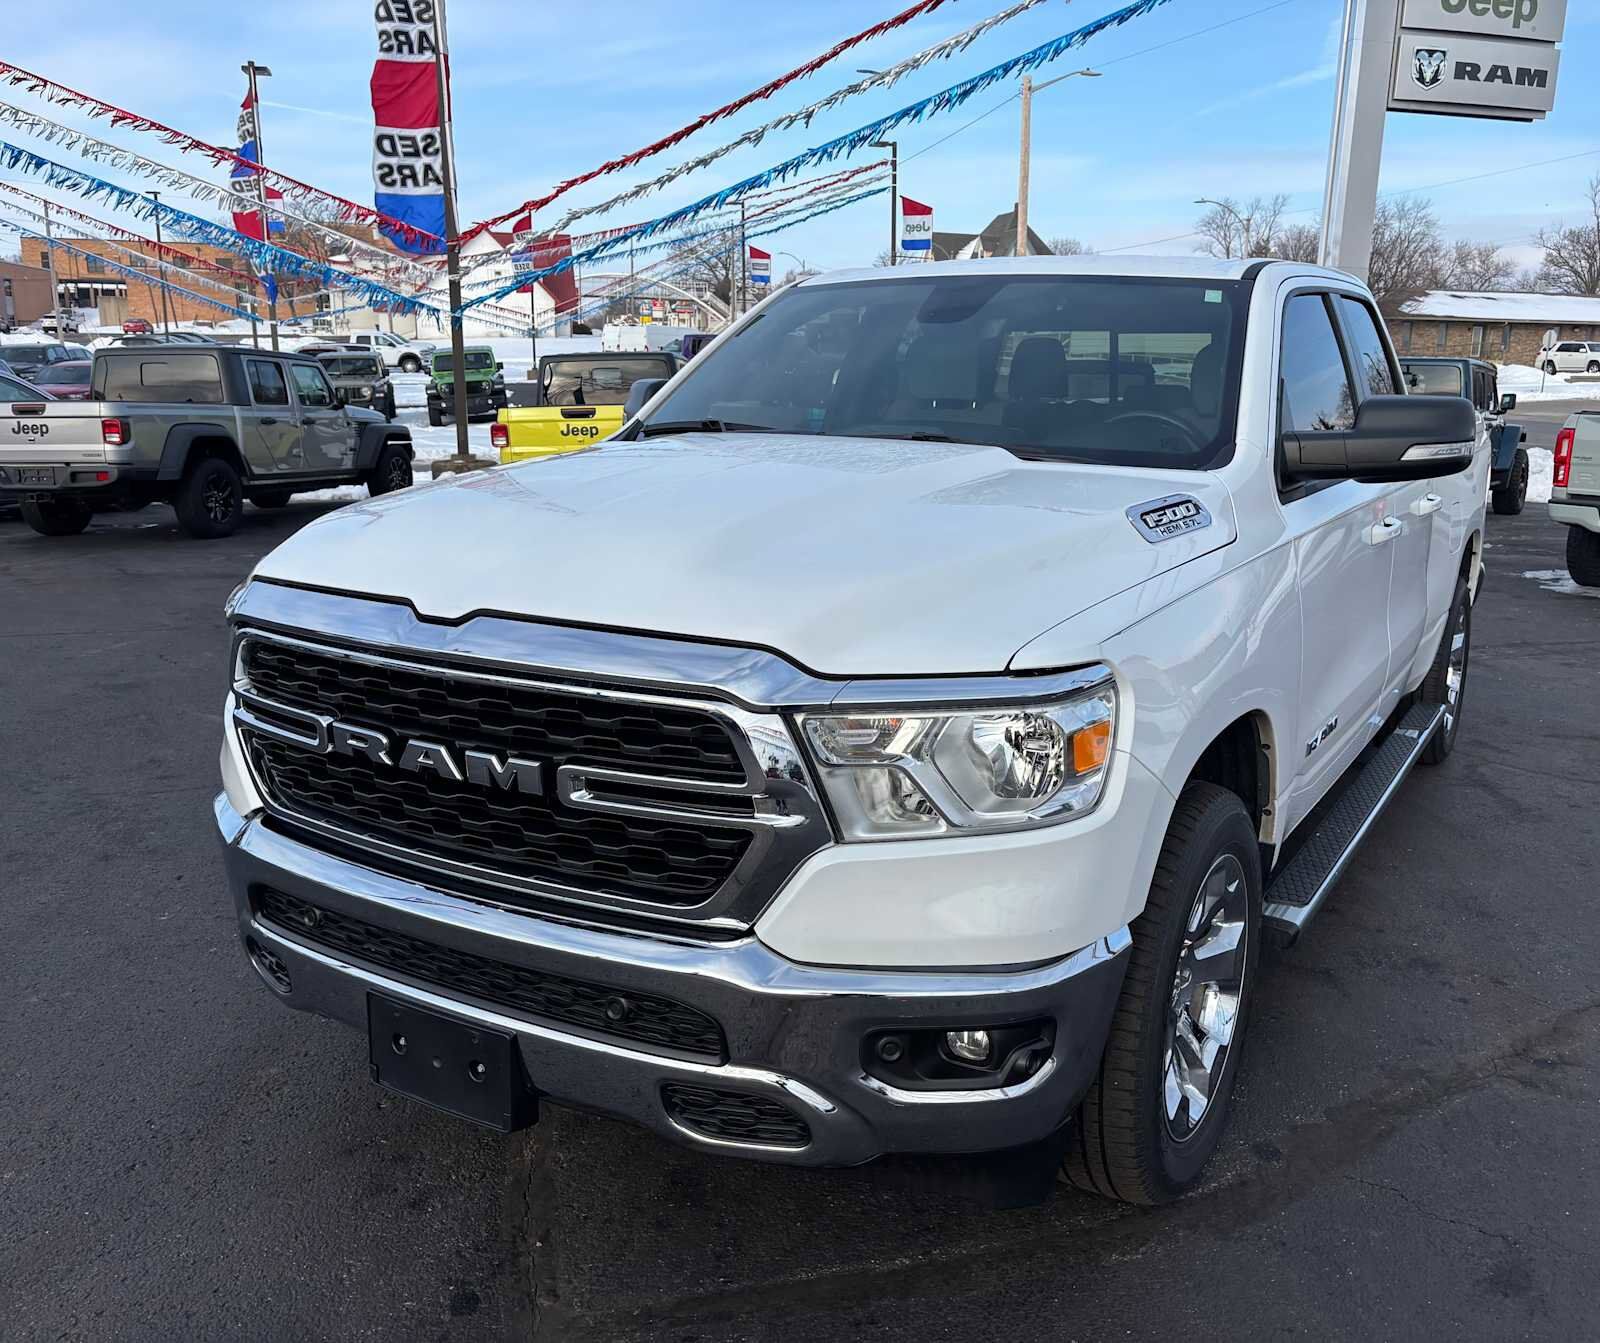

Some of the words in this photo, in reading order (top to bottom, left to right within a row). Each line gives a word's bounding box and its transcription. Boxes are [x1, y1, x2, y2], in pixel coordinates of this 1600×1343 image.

[1453, 61, 1549, 89] RAM
[11, 421, 49, 437] Jeep
[560, 424, 599, 438] Jeep
[1142, 502, 1197, 528] 1500
[1160, 523, 1182, 537] HEMI
[1183, 518, 1201, 530] 5.7L
[332, 720, 544, 796] RAM
